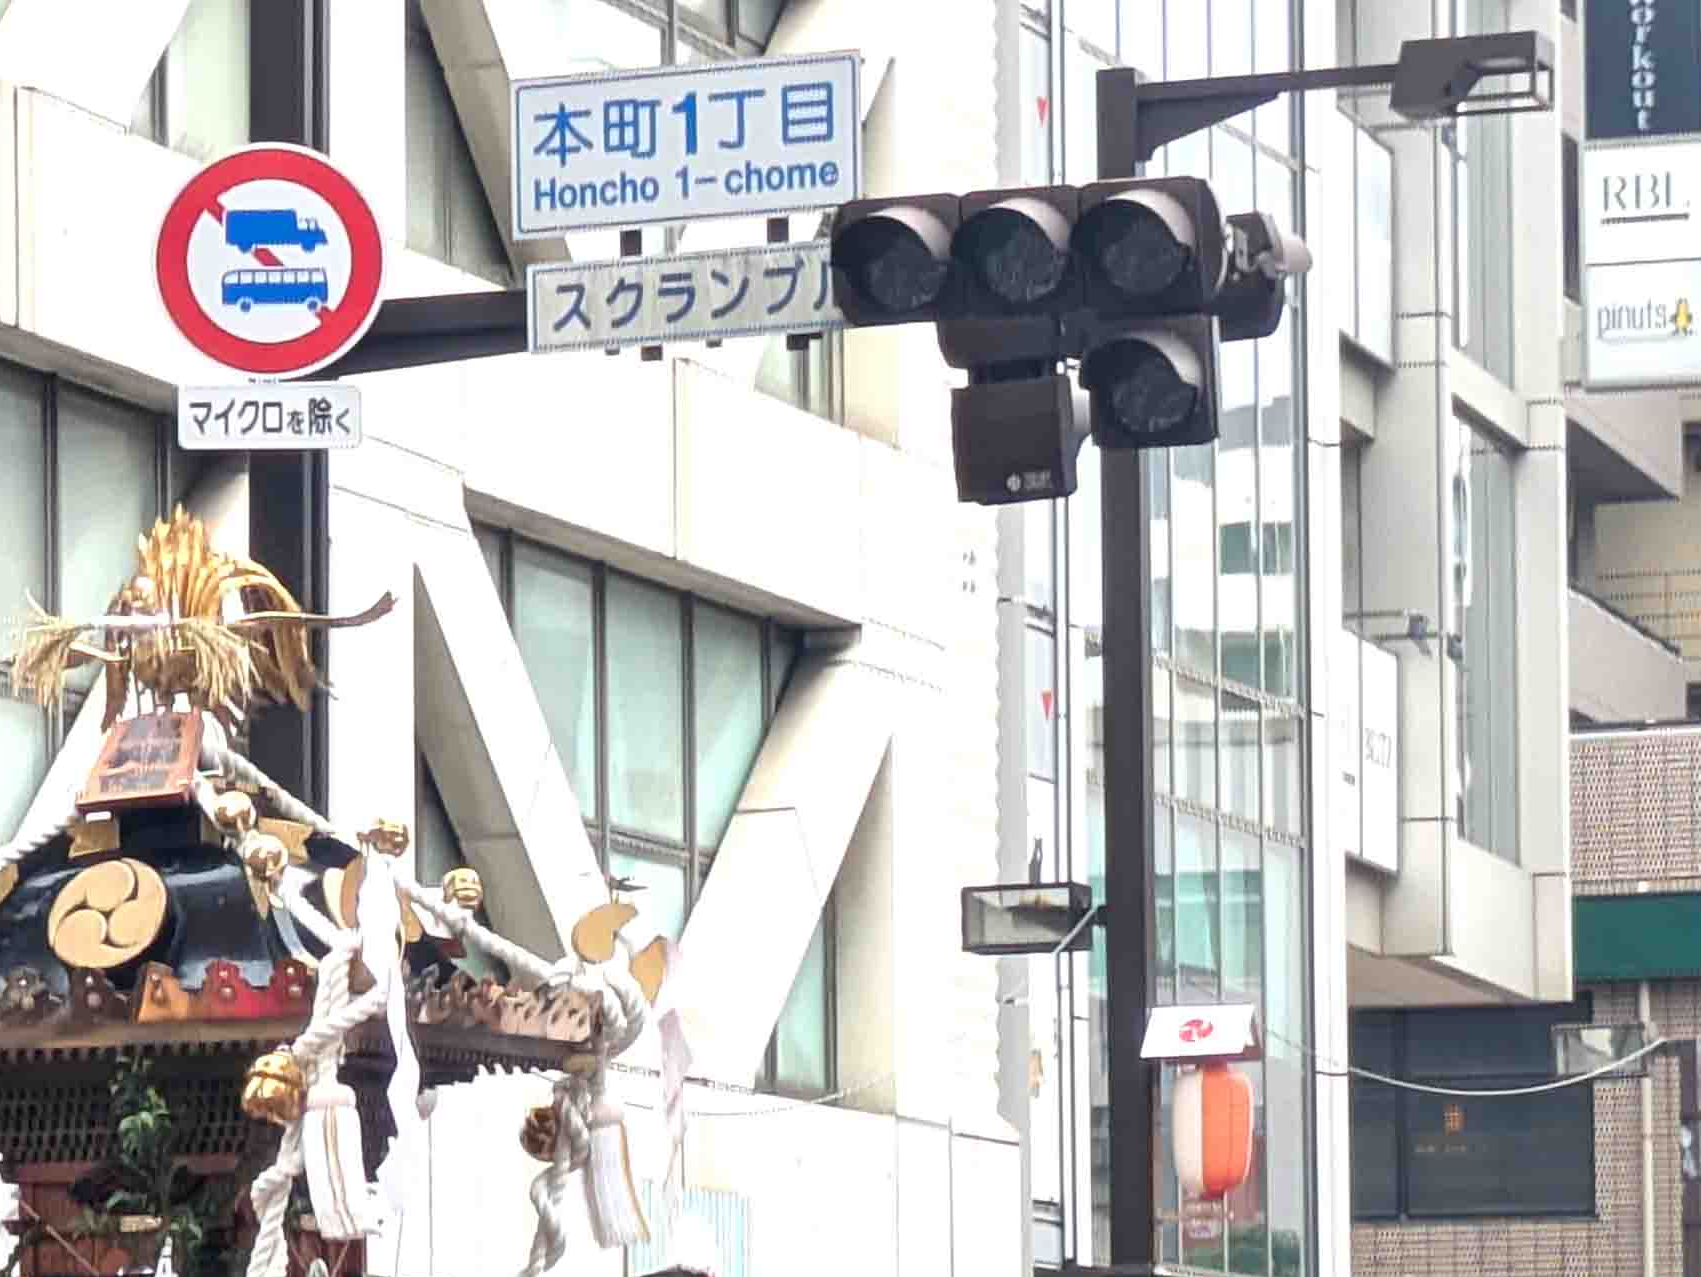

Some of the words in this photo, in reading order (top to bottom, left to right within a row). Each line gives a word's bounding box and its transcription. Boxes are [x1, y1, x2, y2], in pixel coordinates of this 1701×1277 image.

[533, 81, 834, 168] 本町1丁目
[533, 171, 660, 211] Honcho
[188, 396, 351, 436] マイクロを除く
